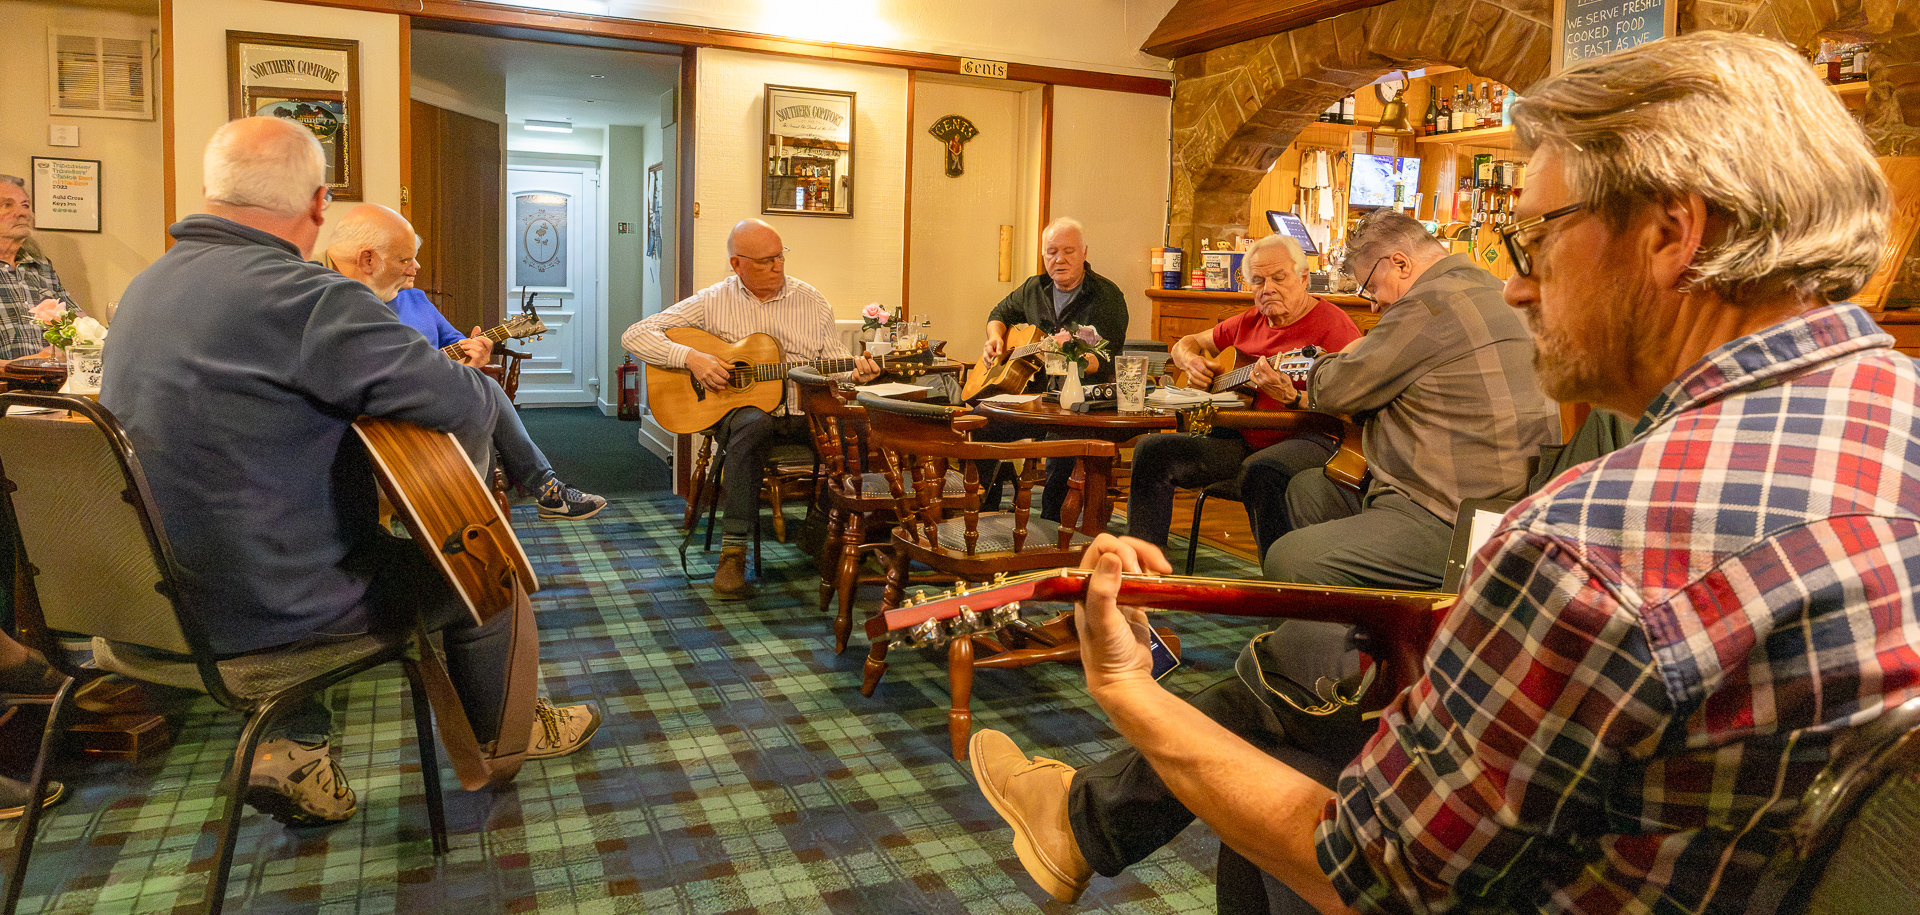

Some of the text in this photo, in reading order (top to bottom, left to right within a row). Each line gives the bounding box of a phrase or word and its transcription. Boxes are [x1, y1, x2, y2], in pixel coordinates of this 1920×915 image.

[1567, 16, 1582, 30] WE
[1586, 6, 1619, 25] SERVE
[1567, 16, 1645, 44] COOKED FOOD
[1566, 32, 1650, 61] AS FAST AS WE
[249, 59, 340, 84] SOUTHERN COMFORT
[964, 61, 1004, 76] Gents
[776, 105, 844, 127] SOUTHERN COMFORT
[935, 118, 974, 138] GENTS
